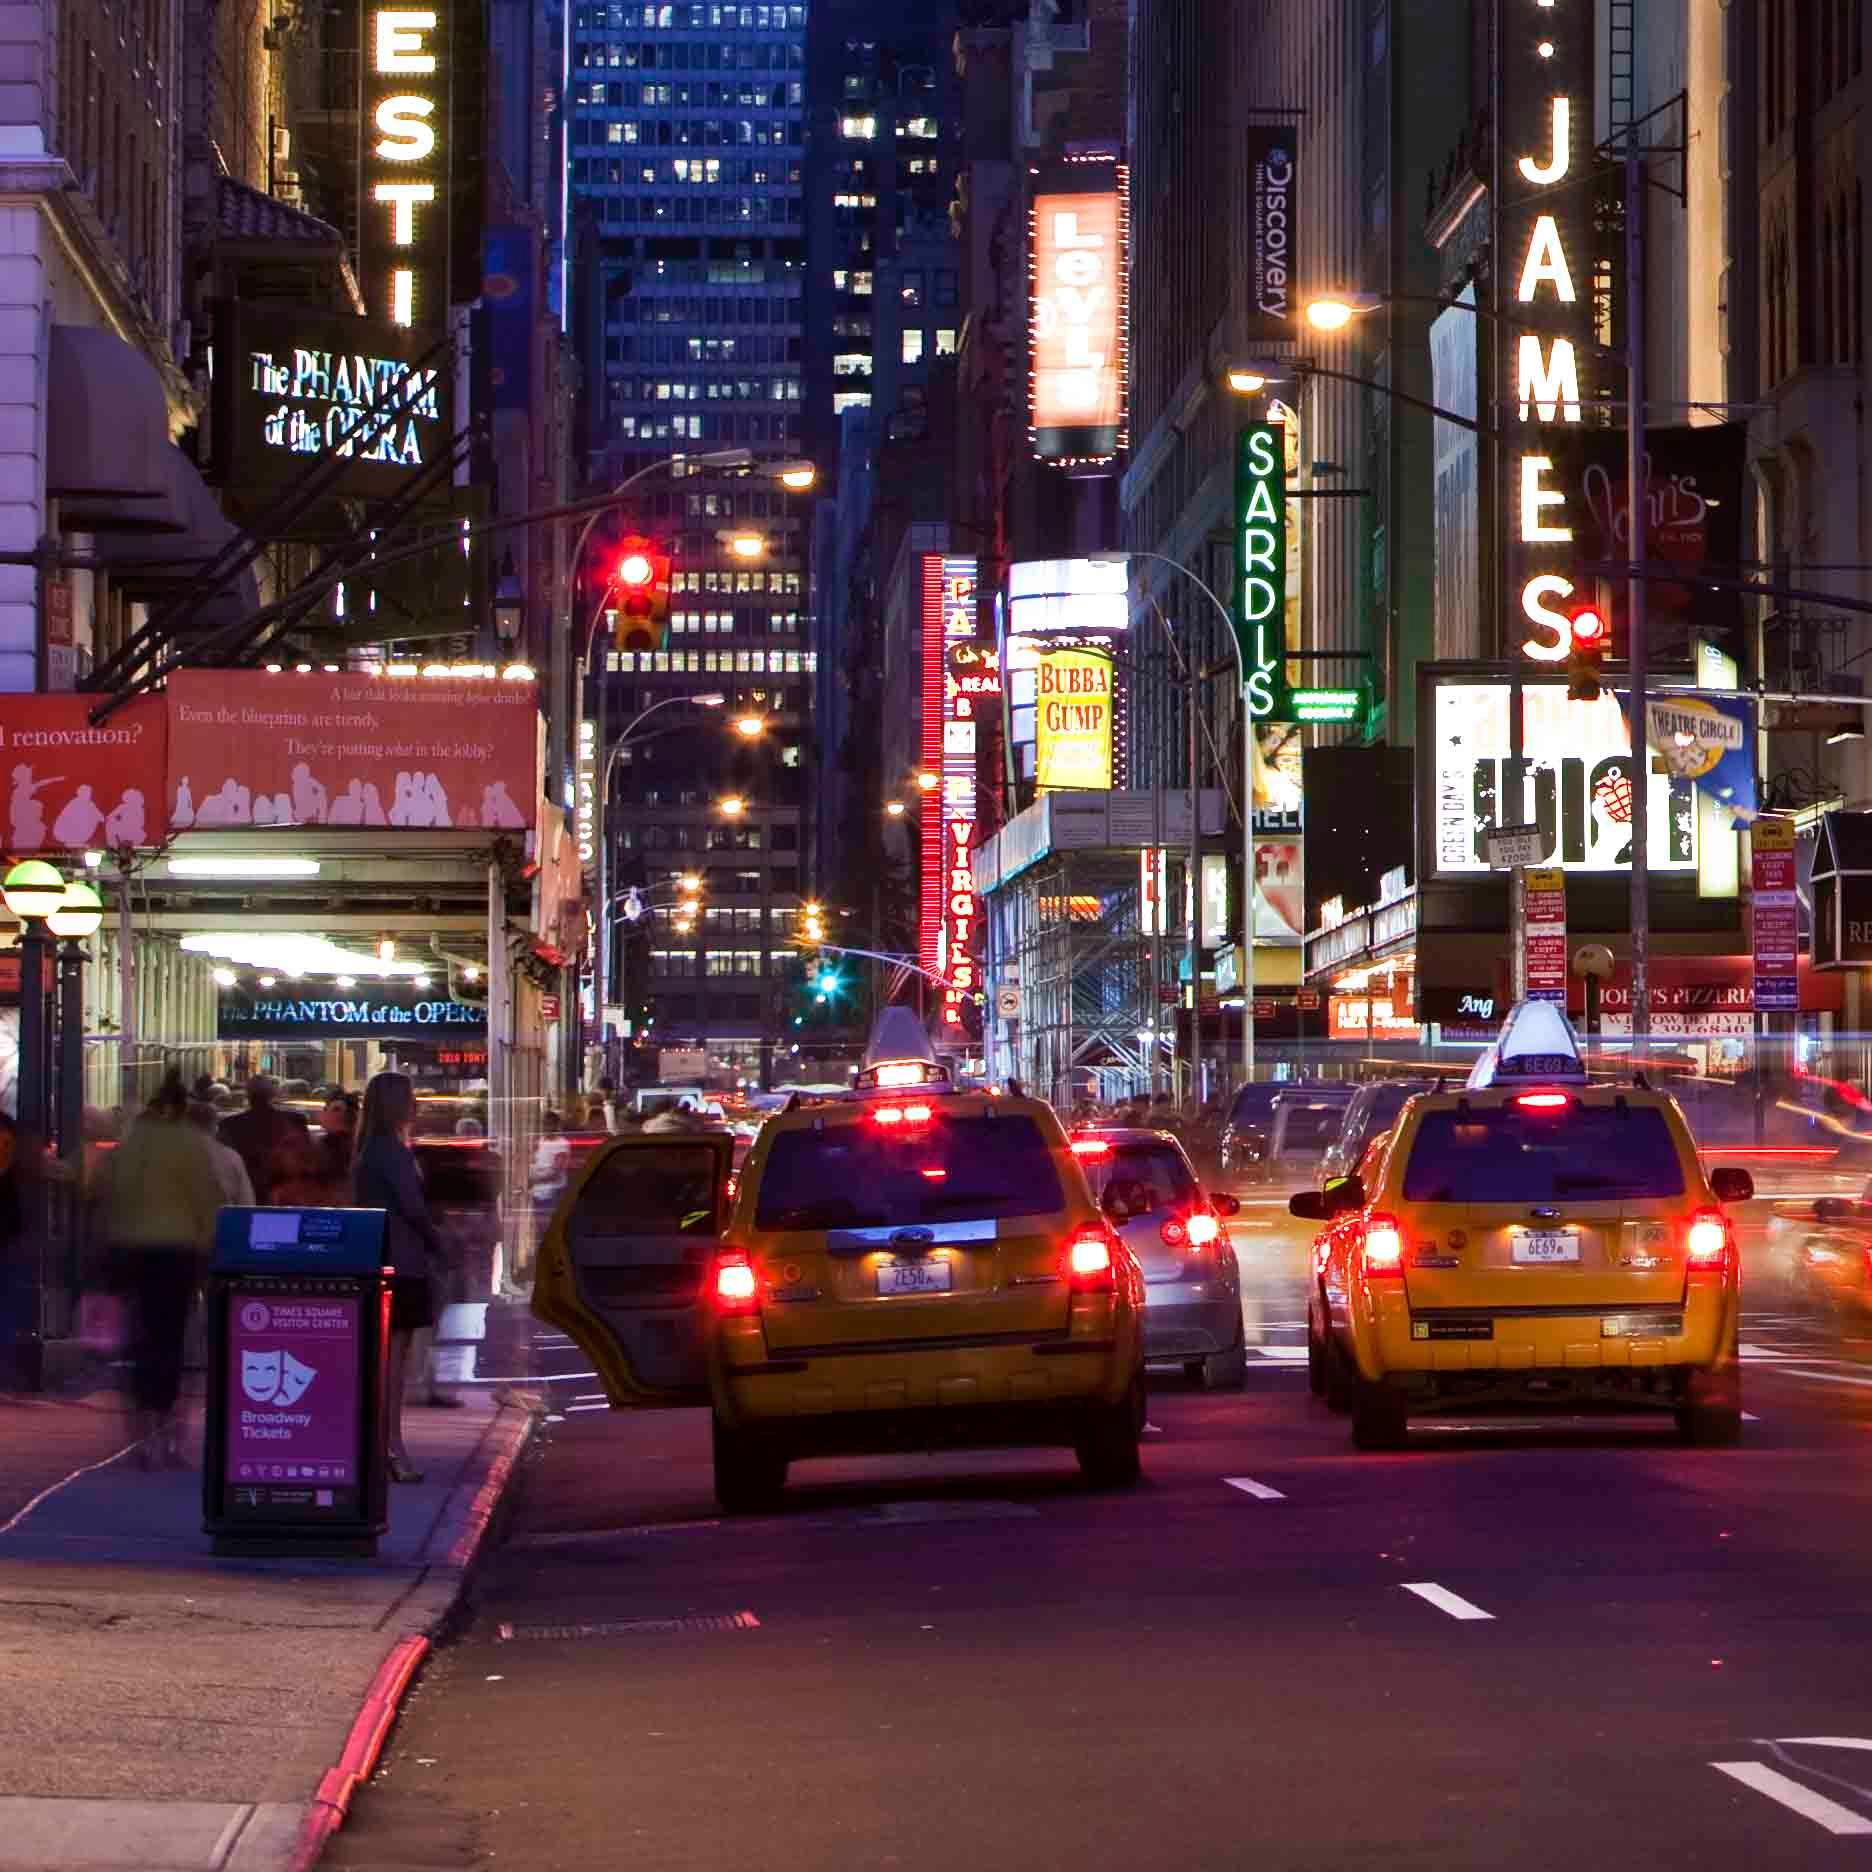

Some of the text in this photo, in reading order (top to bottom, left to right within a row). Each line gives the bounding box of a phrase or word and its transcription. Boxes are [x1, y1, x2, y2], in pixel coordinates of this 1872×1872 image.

[251, 349, 439, 418] The PHANTOM
[1516, 95, 1582, 662] JAMES
[265, 405, 423, 464] of the OPERA
[961, 677, 1002, 693] REAL
[1040, 662, 1108, 694] BUBBA
[179, 705, 211, 722] Even
[217, 707, 239, 723] the
[241, 707, 307, 729] blueprints
[311, 714, 332, 726] are
[1046, 701, 1104, 731] GUMP
[1652, 708, 1736, 740] THEATRE CIRCLE
[12, 722, 143, 748] renovation?
[285, 738, 336, 759] They're
[337, 741, 383, 760] putting
[416, 742, 429, 757] in
[431, 742, 451, 758] the
[453, 744, 495, 762] lobby?
[253, 1001, 369, 1024] PHANTOM
[371, 1006, 389, 1024] of
[389, 1005, 413, 1024] the
[414, 1001, 489, 1024] OPERA
[311, 1318, 349, 1329] CENTER
[241, 1410, 311, 1427] Broadway
[241, 1426, 292, 1440] Tickets
